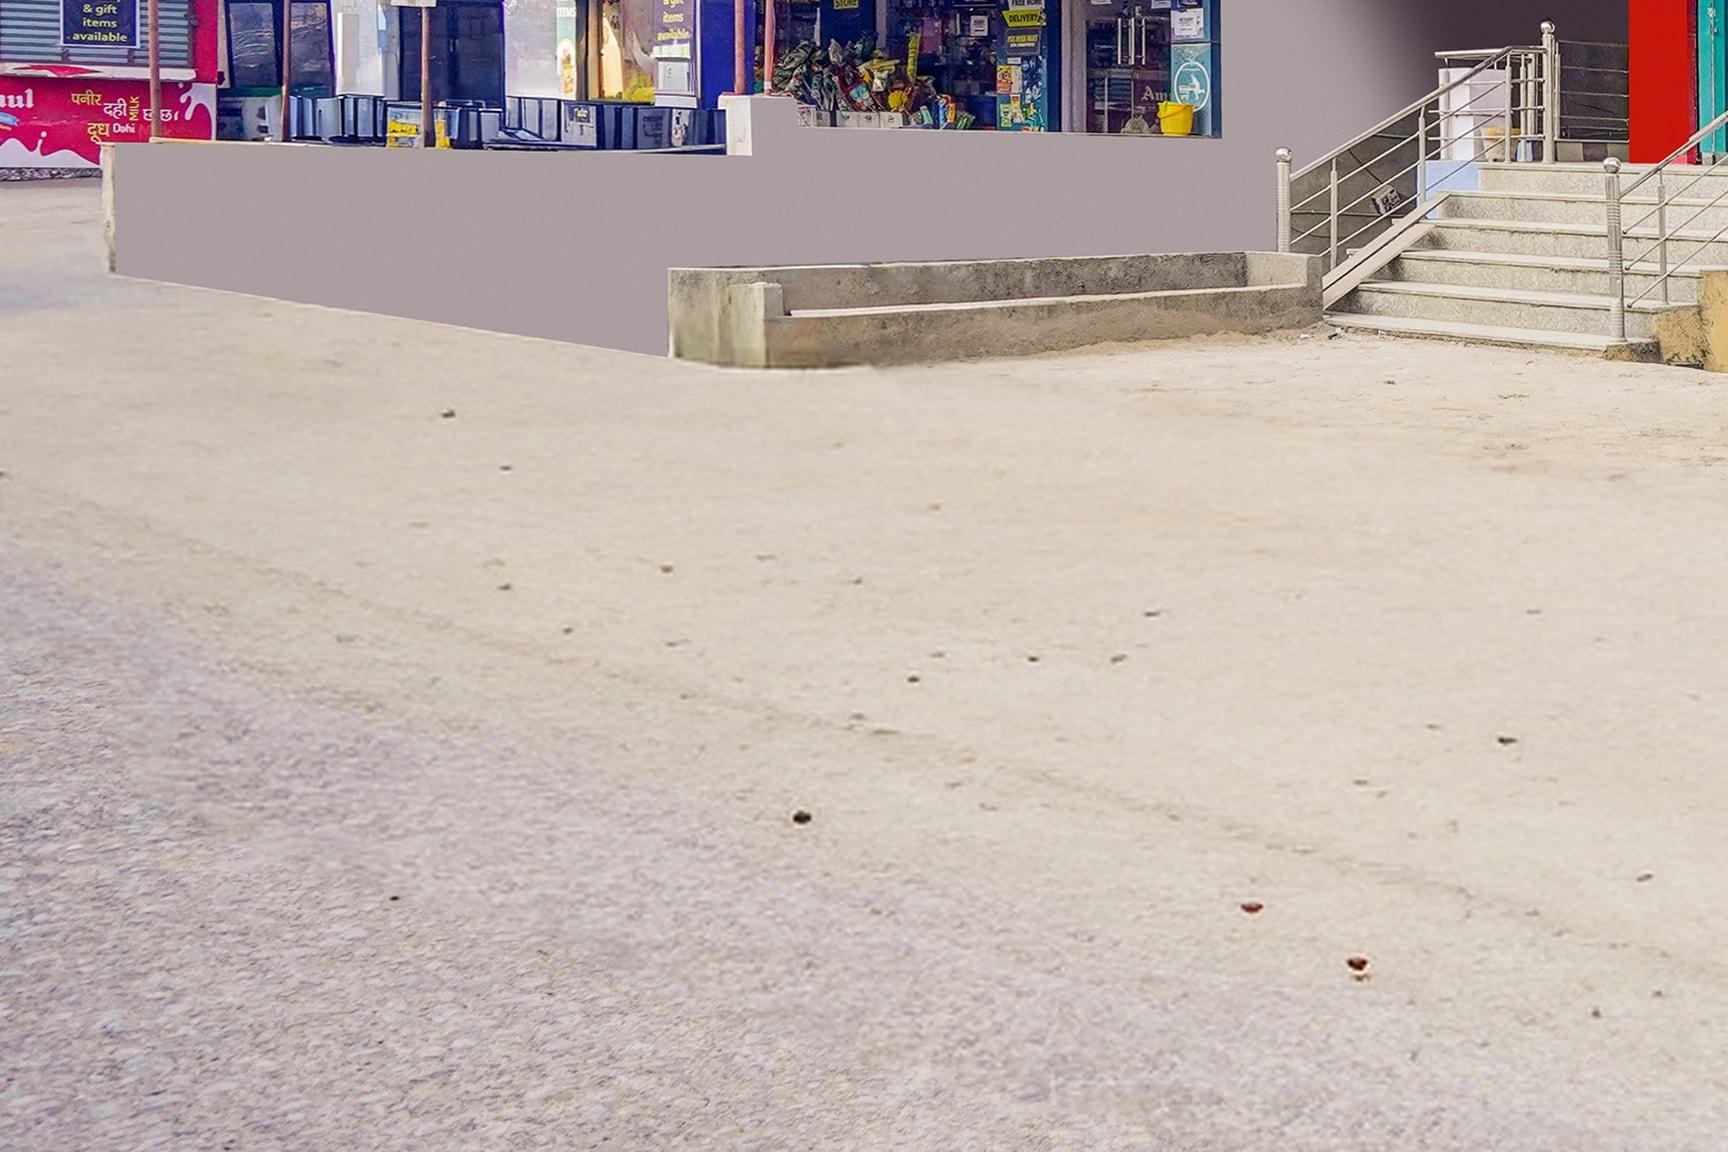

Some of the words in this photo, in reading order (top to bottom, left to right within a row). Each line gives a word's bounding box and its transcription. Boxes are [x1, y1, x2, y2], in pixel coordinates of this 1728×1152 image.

[82, 4, 93, 13] &
[95, 4, 118, 16] gift
[82, 17, 118, 28] items
[663, 11, 684, 23] items
[1008, 13, 1039, 23] DELIVERY
[72, 31, 128, 42] available
[71, 89, 102, 106] पनीर
[103, 98, 128, 120] दही
[129, 96, 140, 121] MILK
[87, 122, 110, 144] दूध
[112, 123, 136, 134] Dahi
